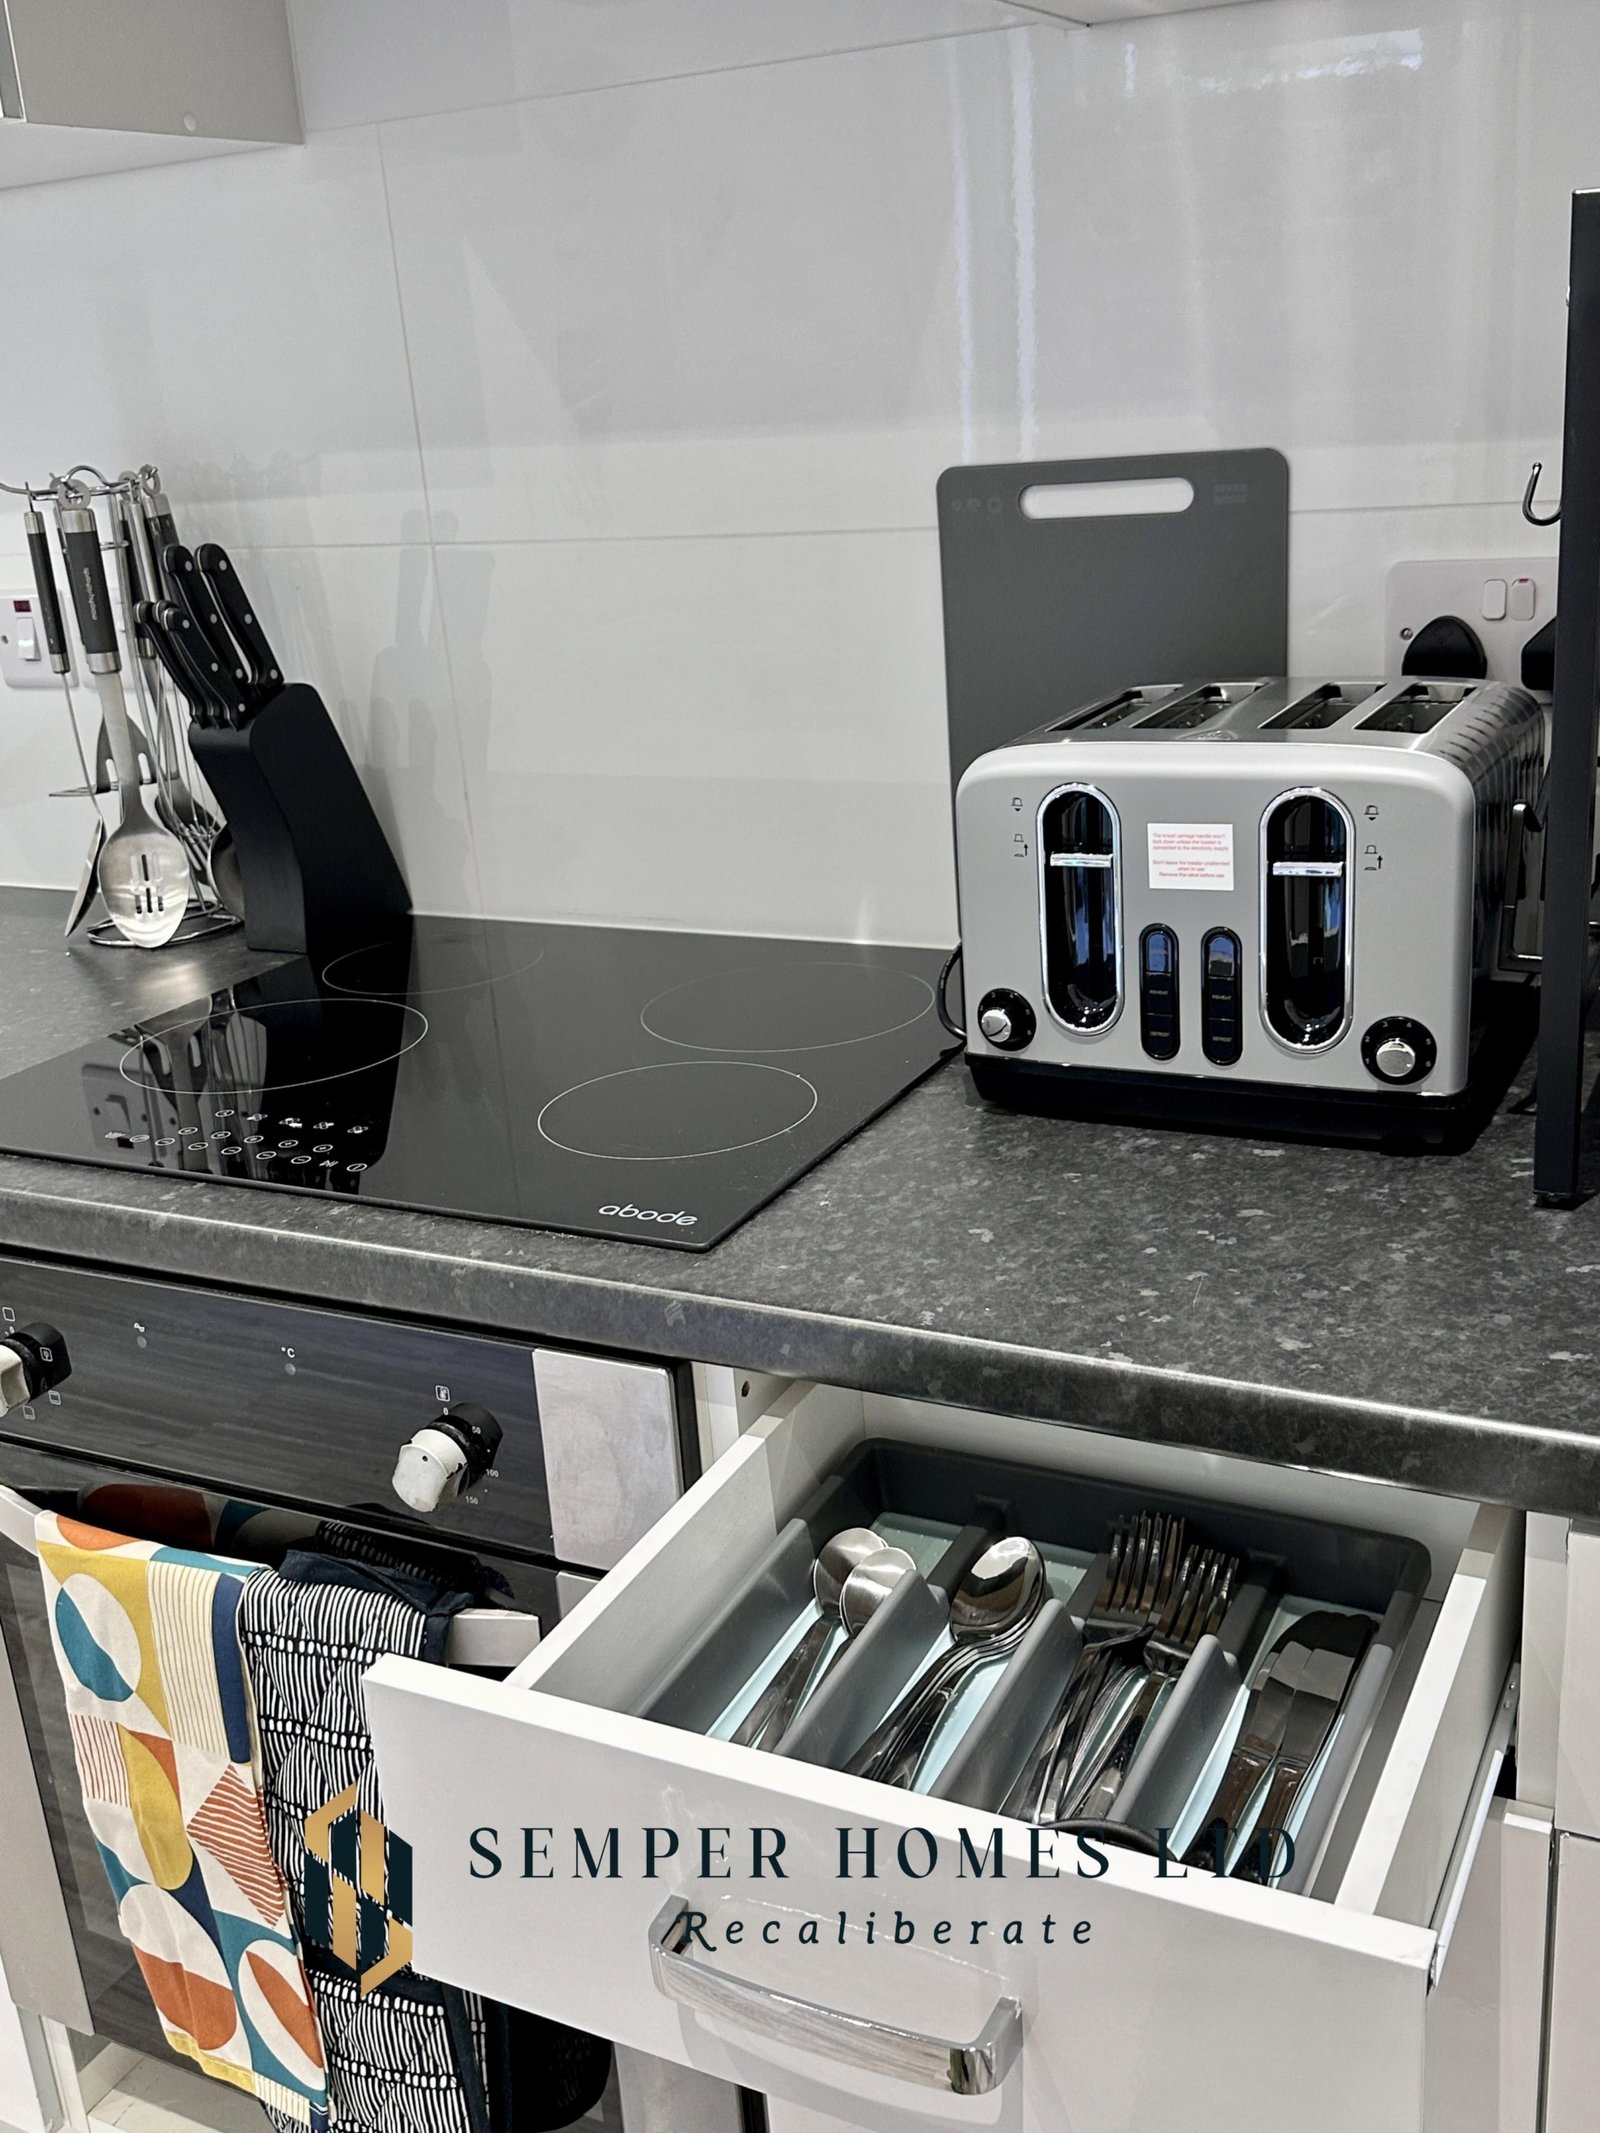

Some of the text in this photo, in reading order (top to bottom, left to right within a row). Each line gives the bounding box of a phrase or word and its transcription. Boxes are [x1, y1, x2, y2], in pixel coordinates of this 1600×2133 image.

[599, 1204, 698, 1226] abode
[443, 1407, 449, 1415] 0
[471, 1426, 481, 1435] 50
[486, 1468, 499, 1478] 100
[465, 1495, 479, 1505] 150
